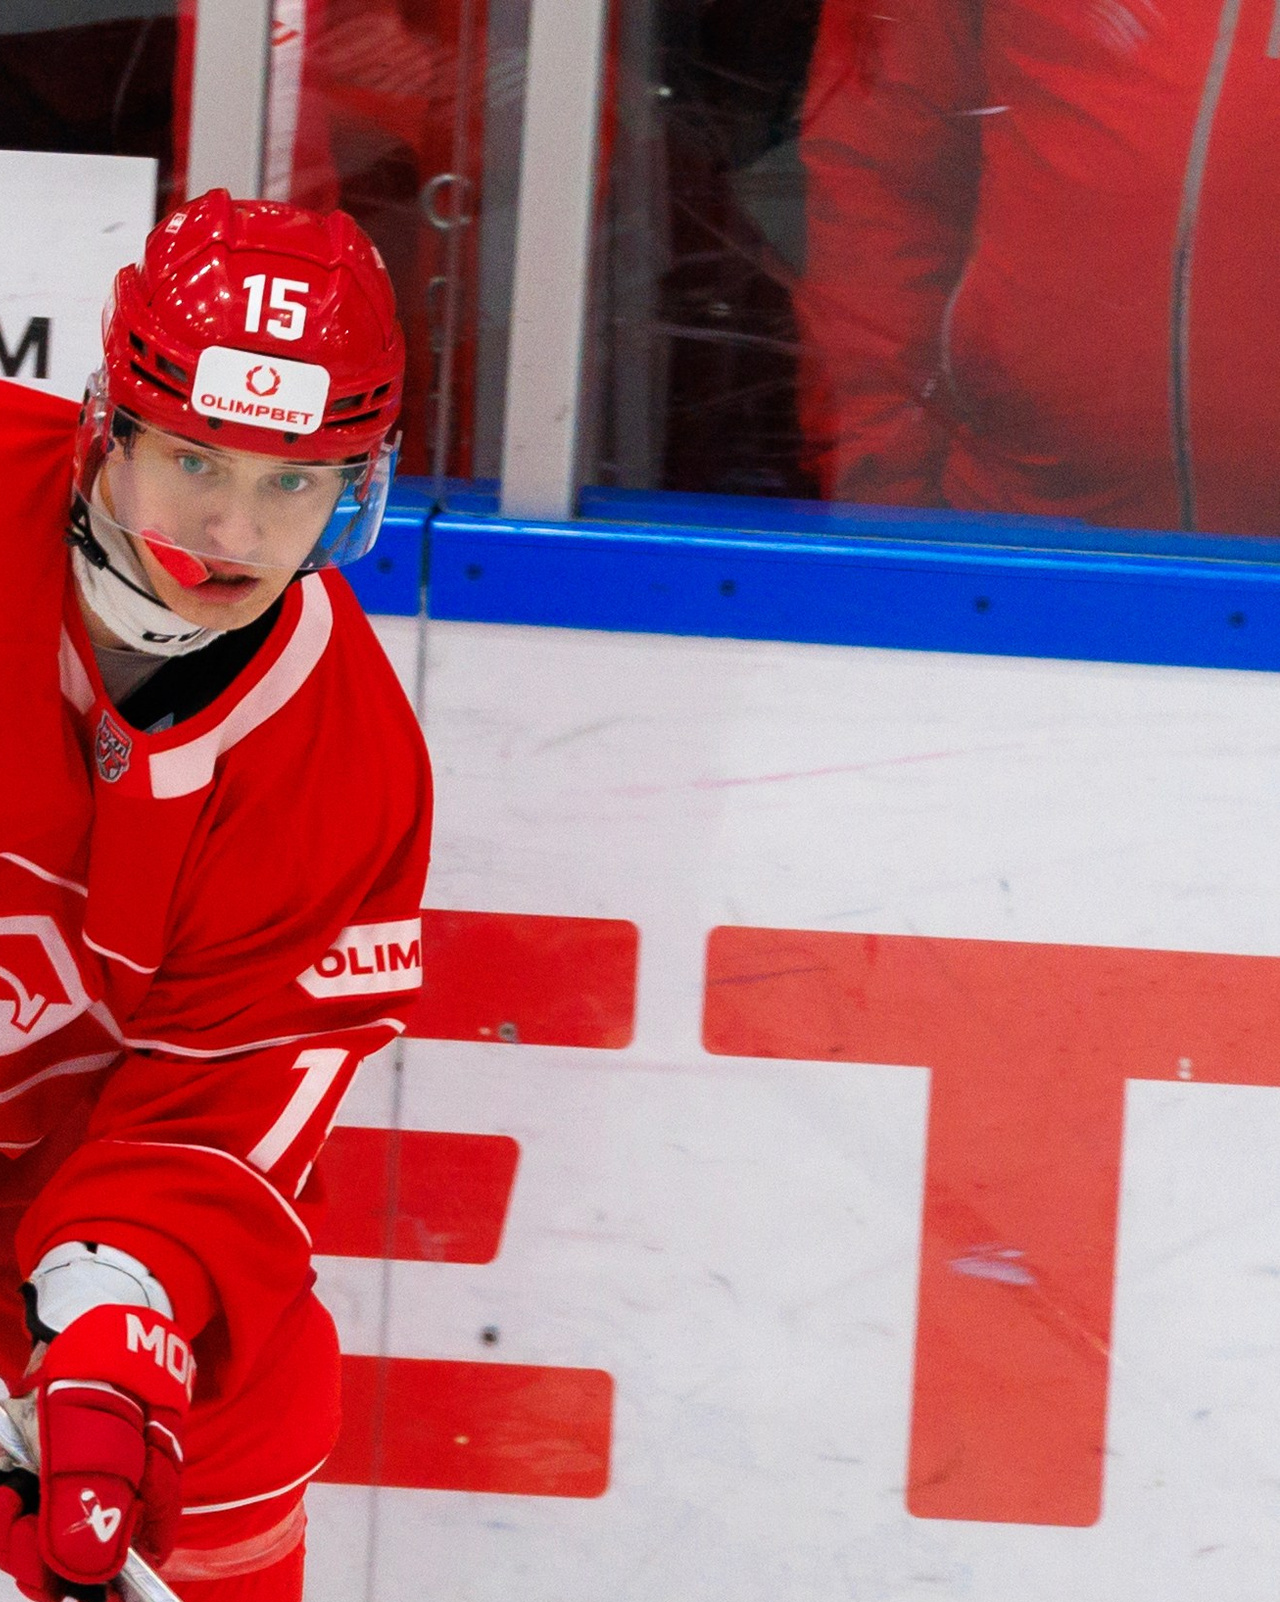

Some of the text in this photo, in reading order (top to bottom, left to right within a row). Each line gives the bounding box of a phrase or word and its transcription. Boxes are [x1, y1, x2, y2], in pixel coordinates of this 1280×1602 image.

[242, 273, 309, 341] 15
[201, 393, 314, 425] OLIMPBET
[246, 1048, 350, 1198] 1
[125, 1312, 196, 1403] МО
